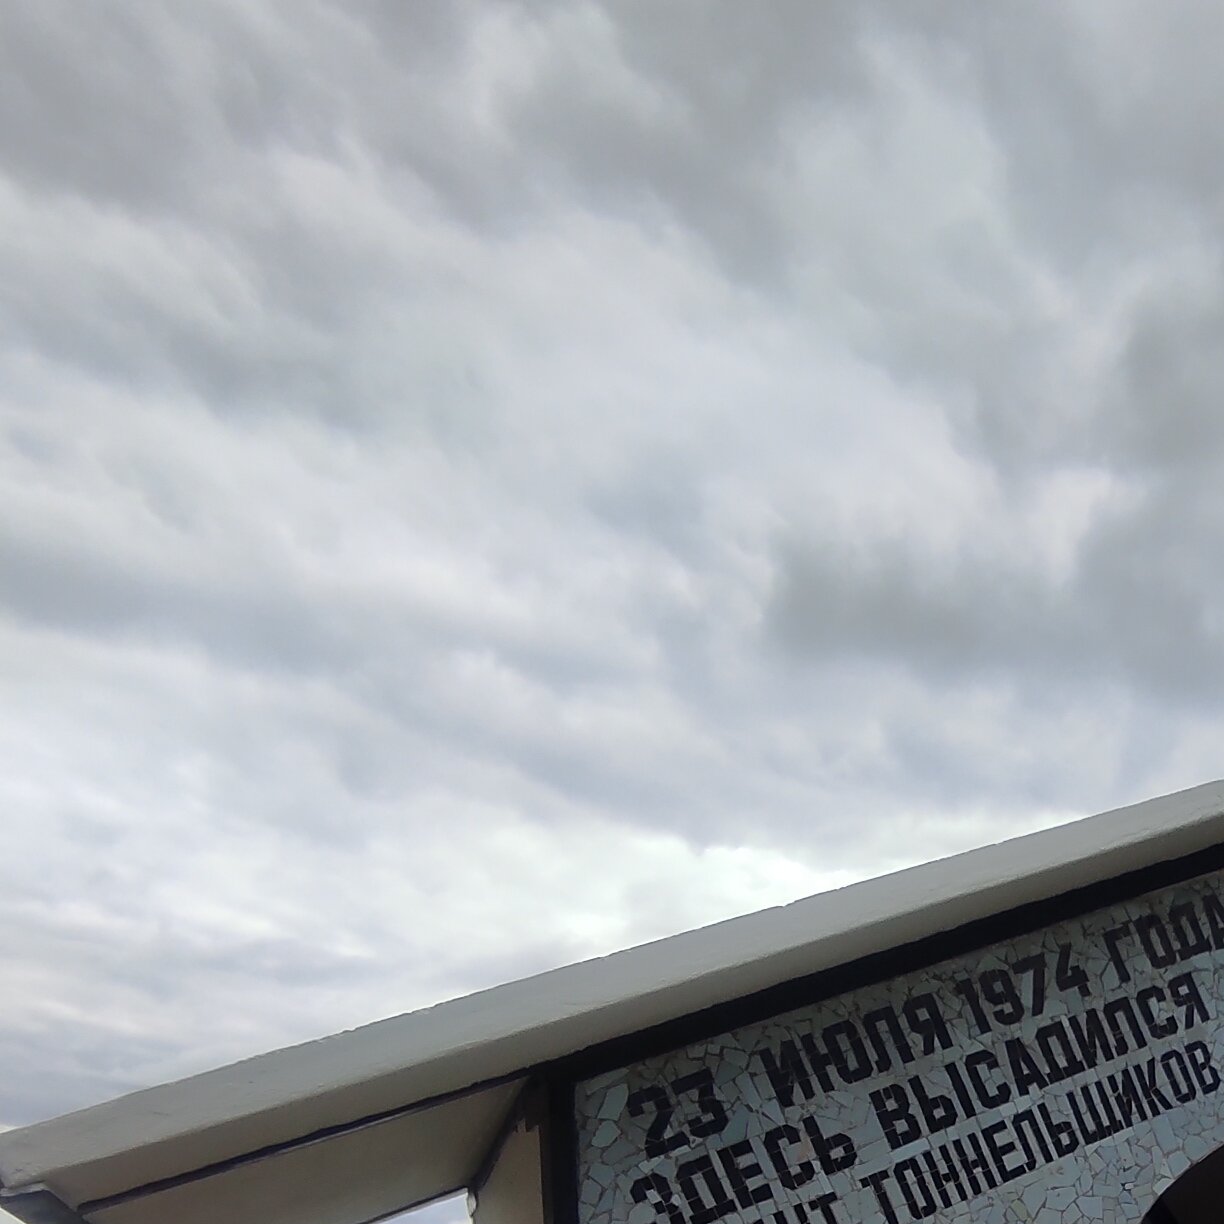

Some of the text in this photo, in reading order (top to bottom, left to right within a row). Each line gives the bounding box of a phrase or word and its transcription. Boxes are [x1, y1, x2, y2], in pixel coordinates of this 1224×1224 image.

[628, 1066, 729, 1158] 23
[760, 992, 953, 1107] ИЮЛЯ
[954, 942, 1091, 1035] 1974
[869, 972, 1210, 1150] ВЫСАДИЛСЯ
